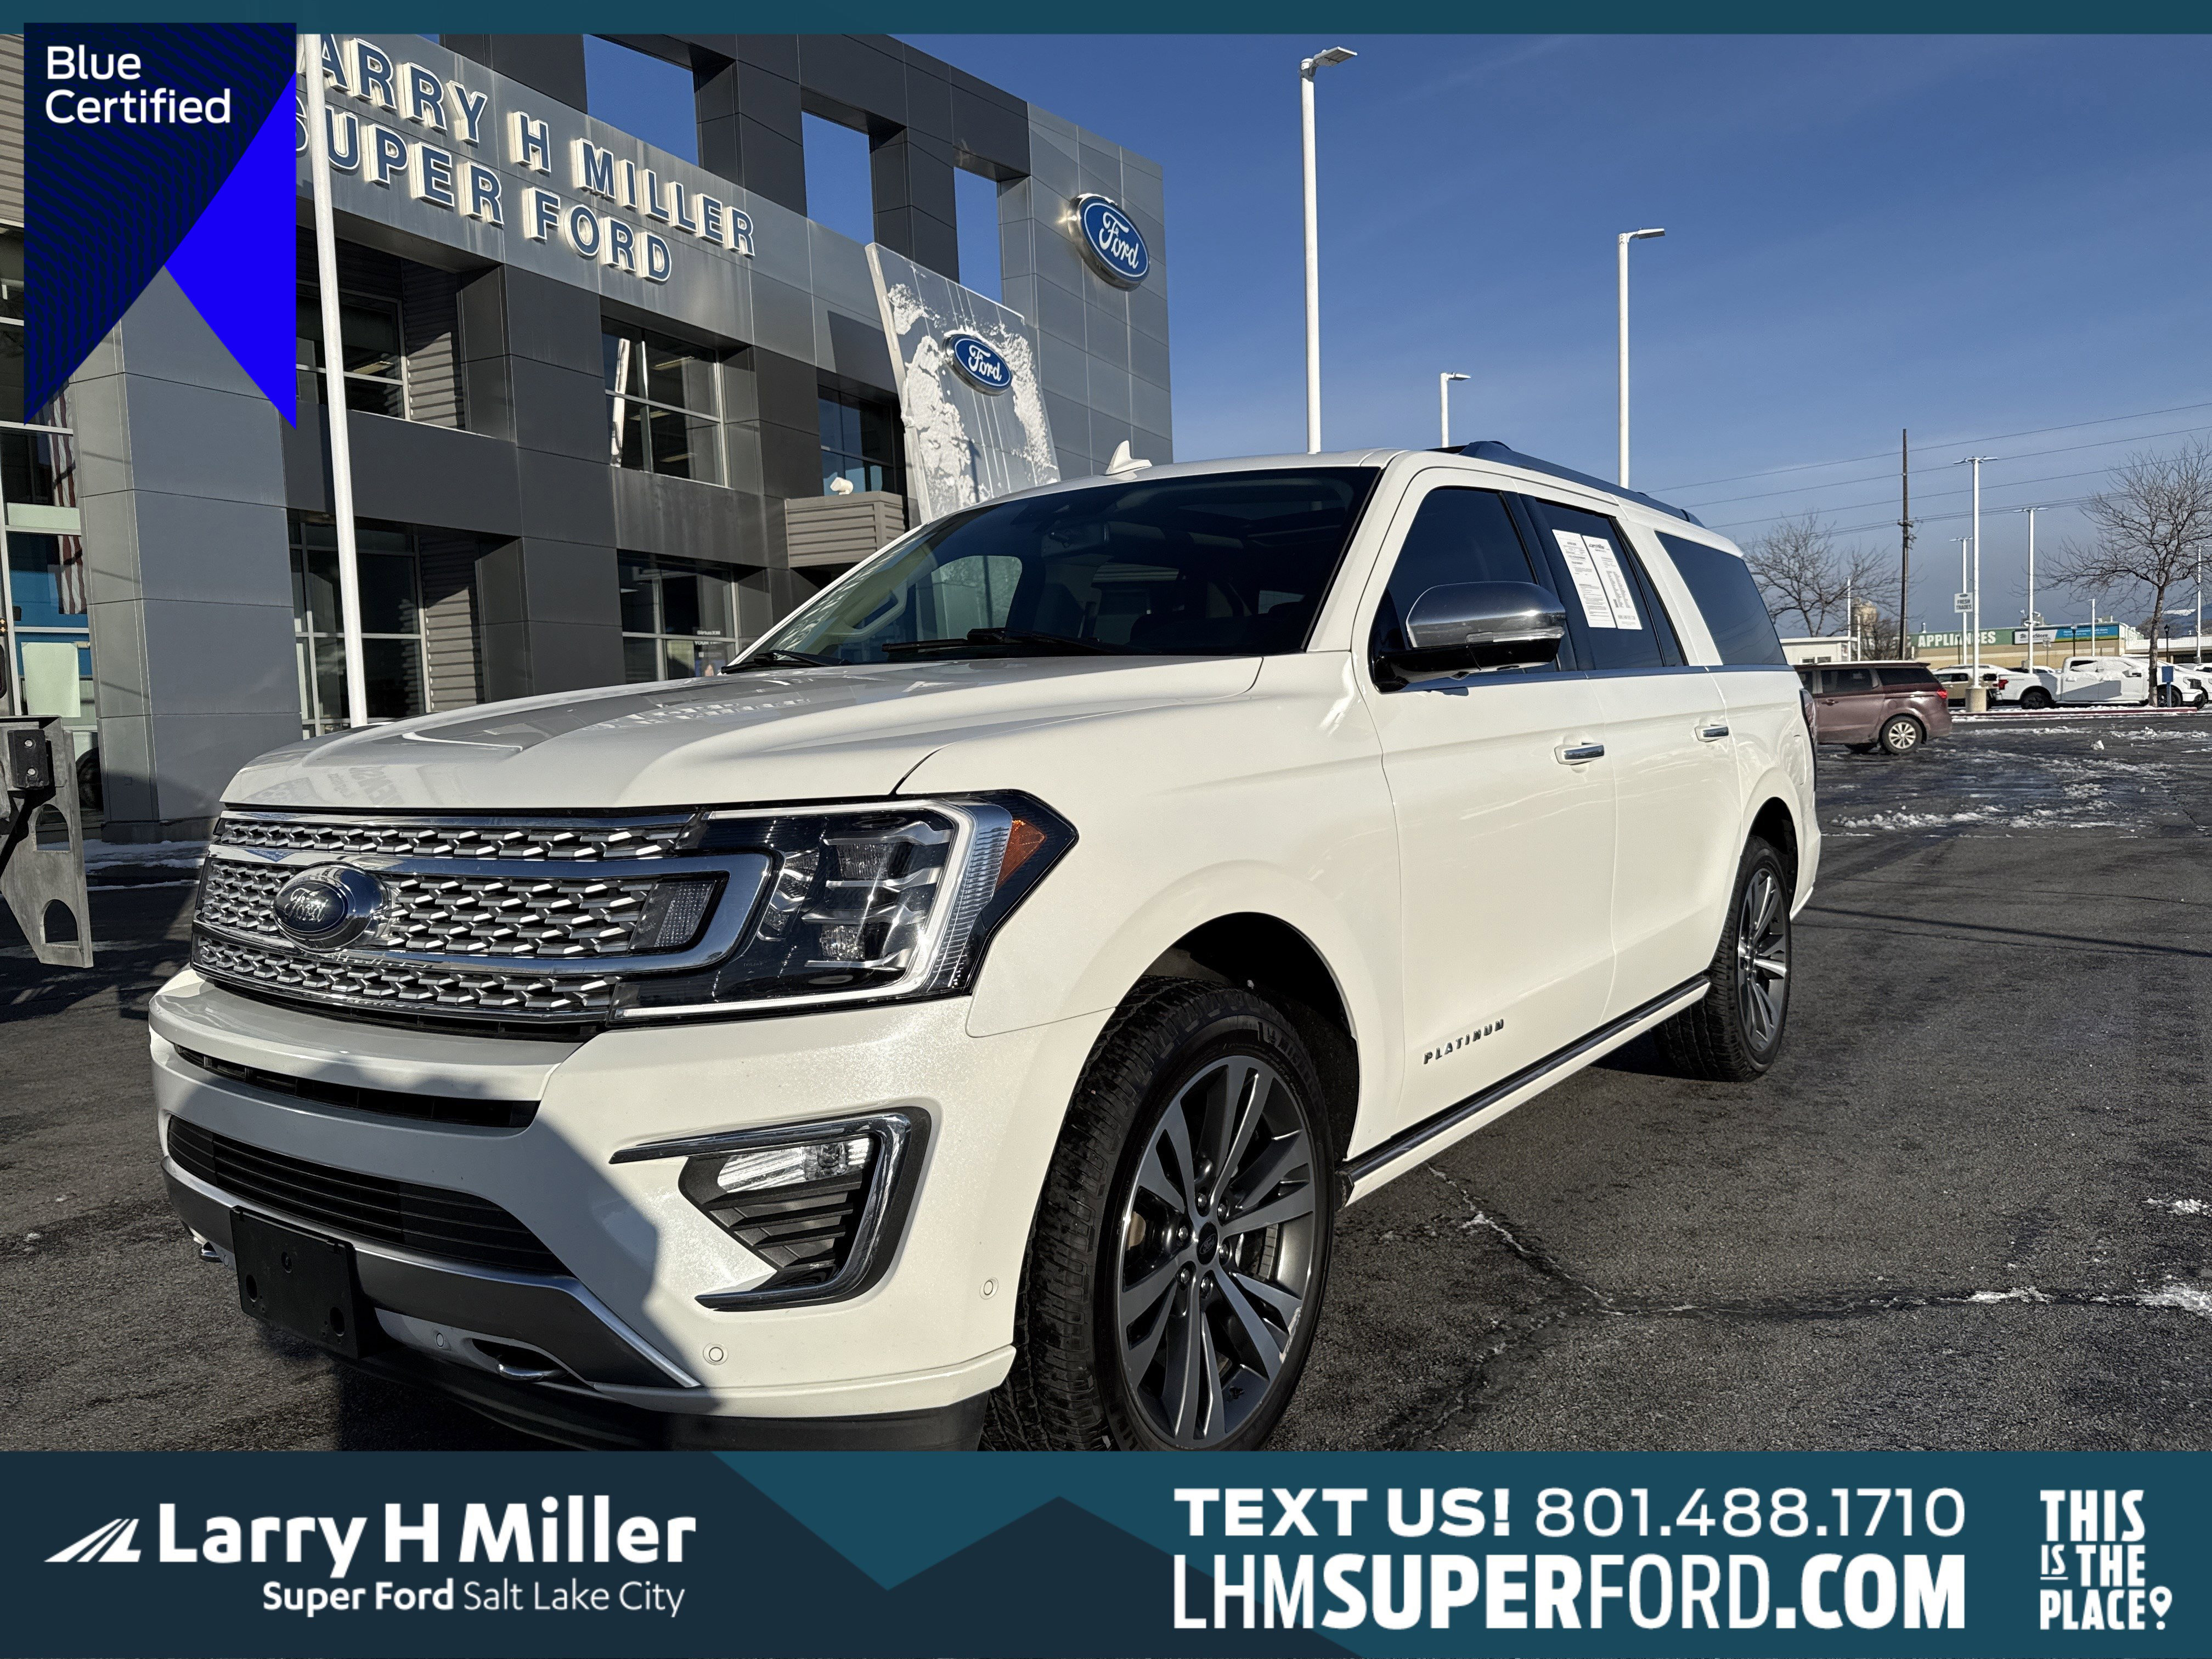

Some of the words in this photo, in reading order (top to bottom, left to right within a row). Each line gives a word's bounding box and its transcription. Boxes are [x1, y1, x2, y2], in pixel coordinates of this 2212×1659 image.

[299, 34, 488, 144] ARRY
[512, 111, 551, 173] H
[575, 138, 755, 257] MILLER
[527, 187, 672, 282] FORD
[1099, 212, 1139, 269] Ford
[968, 345, 1002, 381] Ford
[284, 887, 329, 923] Ford
[1423, 1018, 1504, 1064] PLATINUM
